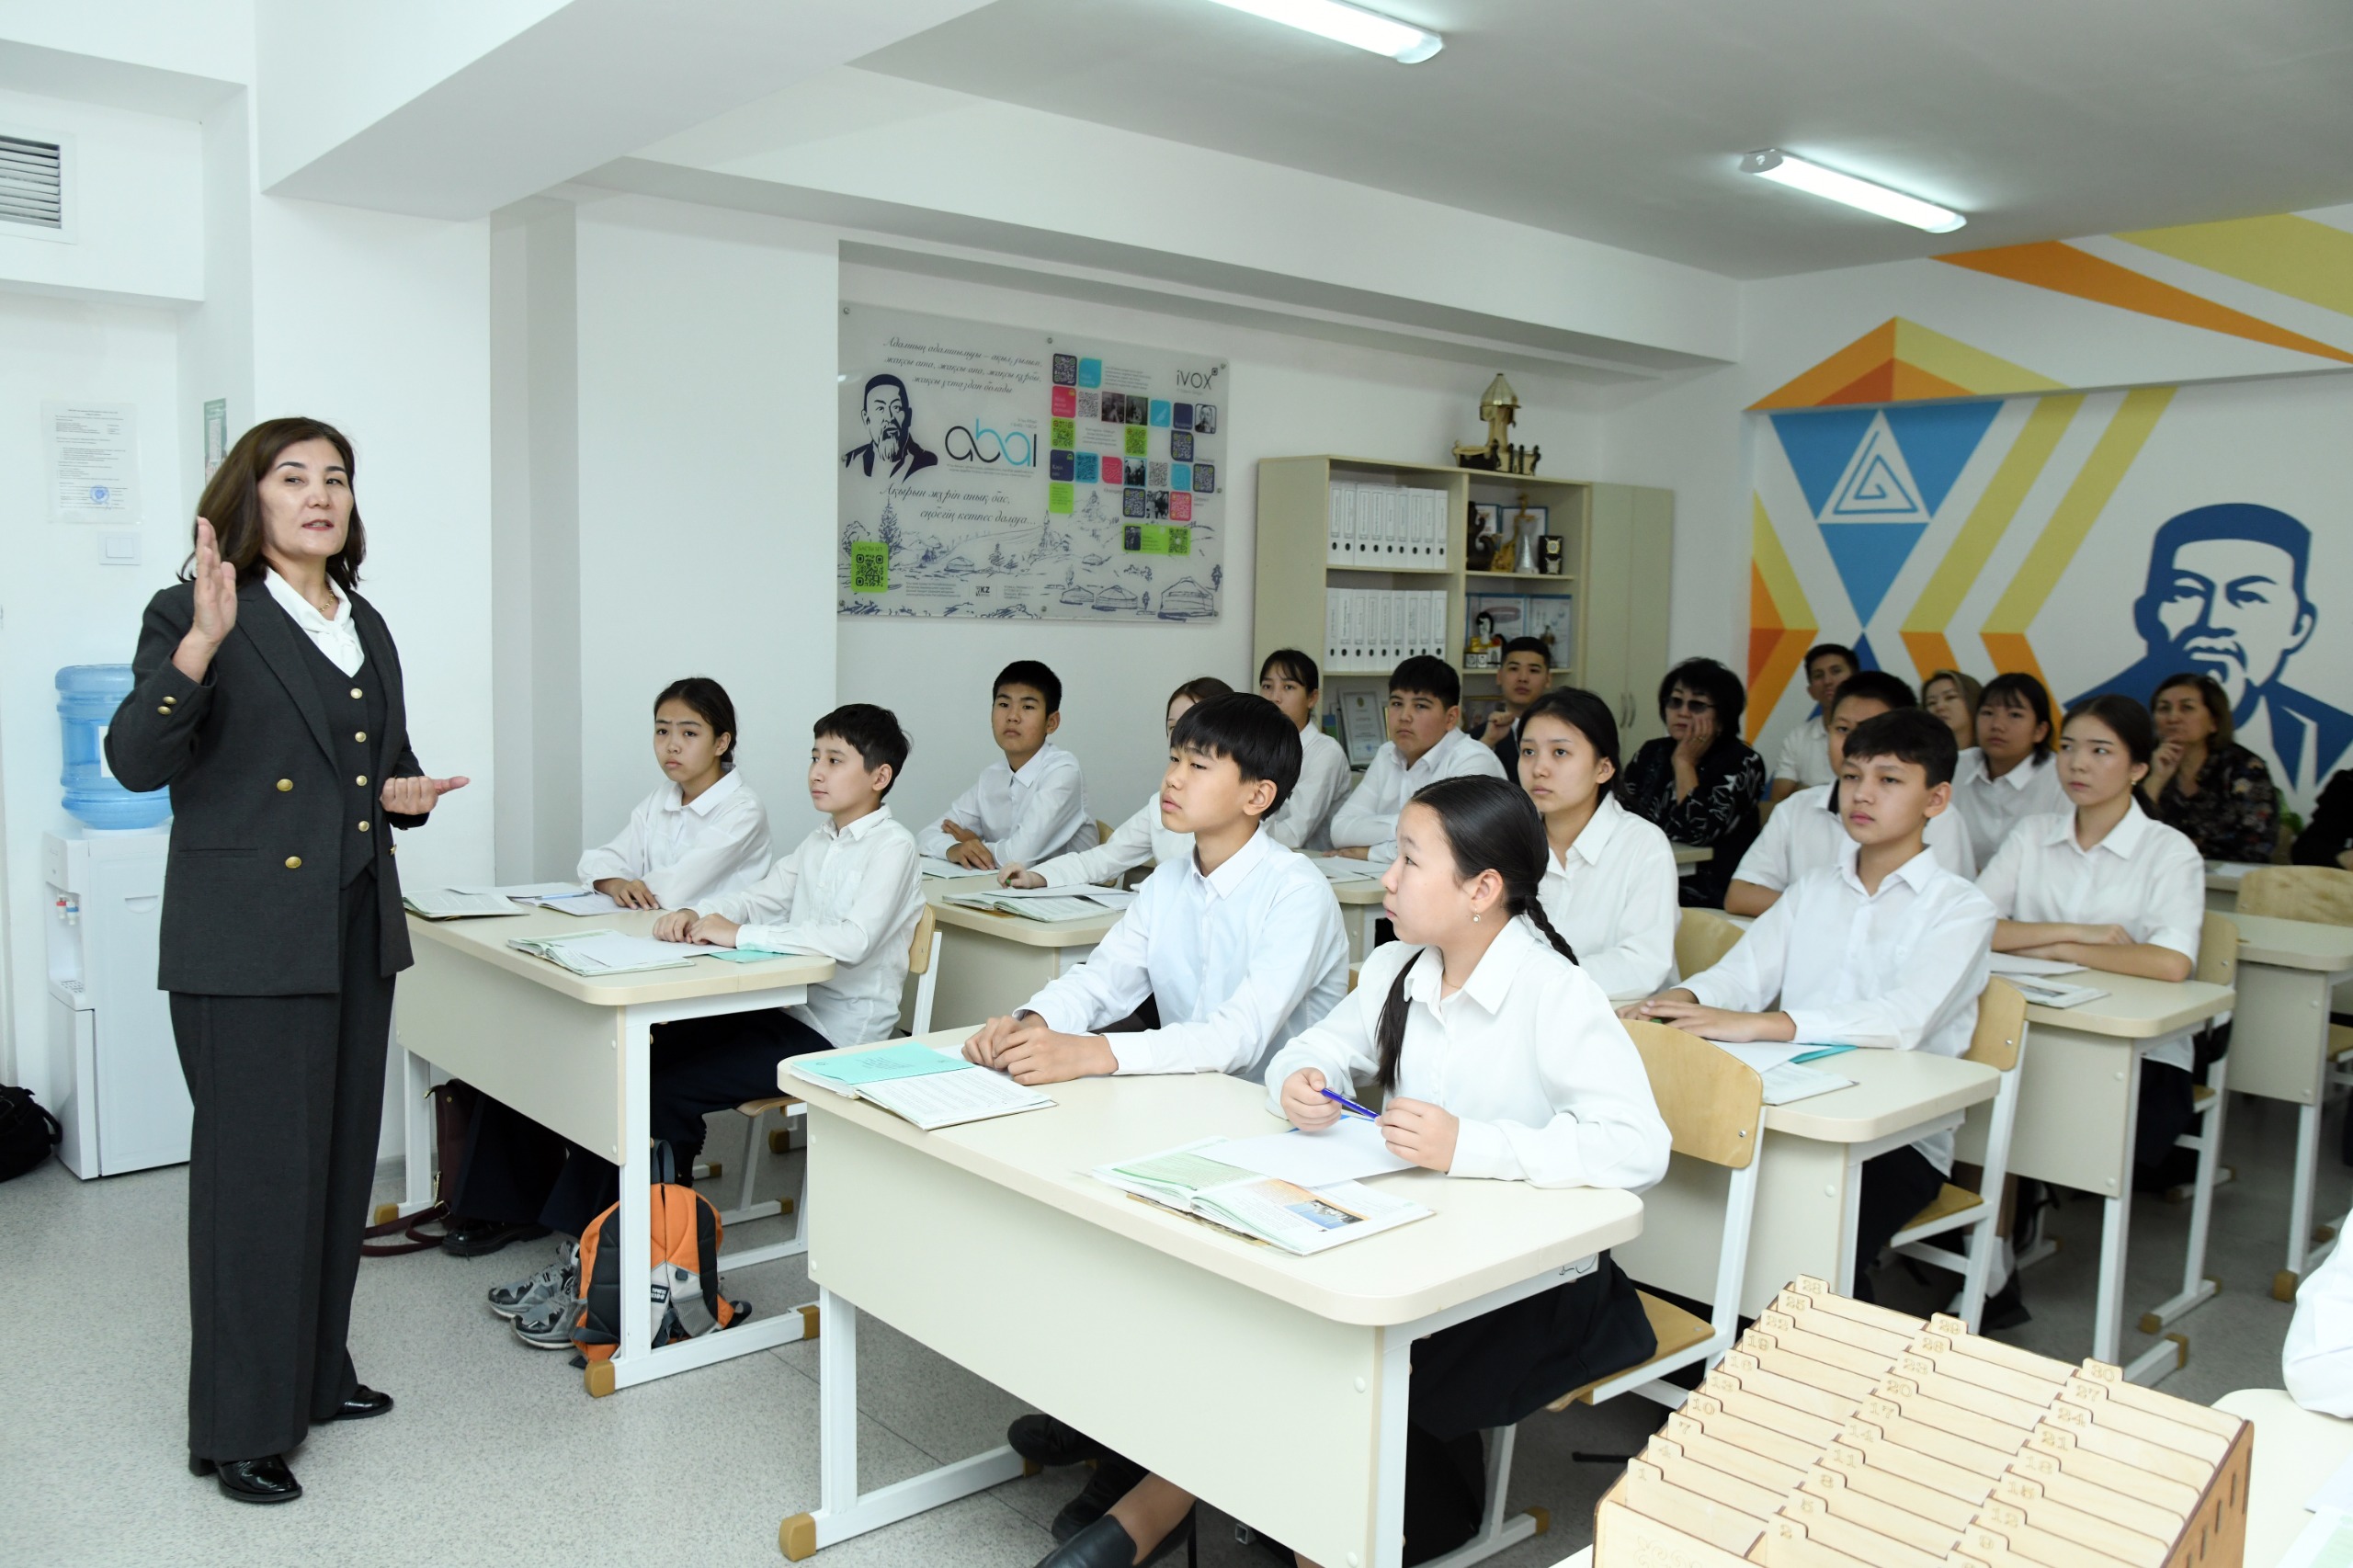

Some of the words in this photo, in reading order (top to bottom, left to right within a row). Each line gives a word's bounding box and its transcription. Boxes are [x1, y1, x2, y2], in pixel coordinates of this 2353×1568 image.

[880, 483, 926, 501] Ақырын
[957, 512, 993, 522] кетпес
[1802, 1279, 1822, 1295] 28
[1785, 1296, 1806, 1312] 25
[1766, 1314, 1789, 1332] 22
[1938, 1319, 1961, 1335] 29
[1747, 1335, 1769, 1351] 19
[1922, 1337, 1944, 1353] 26
[1903, 1358, 1928, 1375] 23
[2091, 1365, 2115, 1382] 30
[1887, 1380, 1912, 1397] 20
[2076, 1385, 2100, 1402] 27
[1692, 1398, 1715, 1415] 10
[1870, 1403, 1894, 1419] 17
[2058, 1407, 2086, 1427] 24
[1679, 1421, 1691, 1434] 7
[1849, 1425, 1873, 1442] 14
[2041, 1431, 2068, 1451] 21
[1834, 1449, 1856, 1469] 11
[1638, 1468, 1647, 1481] 1
[1991, 1507, 2018, 1528] 12
[1779, 1524, 1792, 1540] 2
